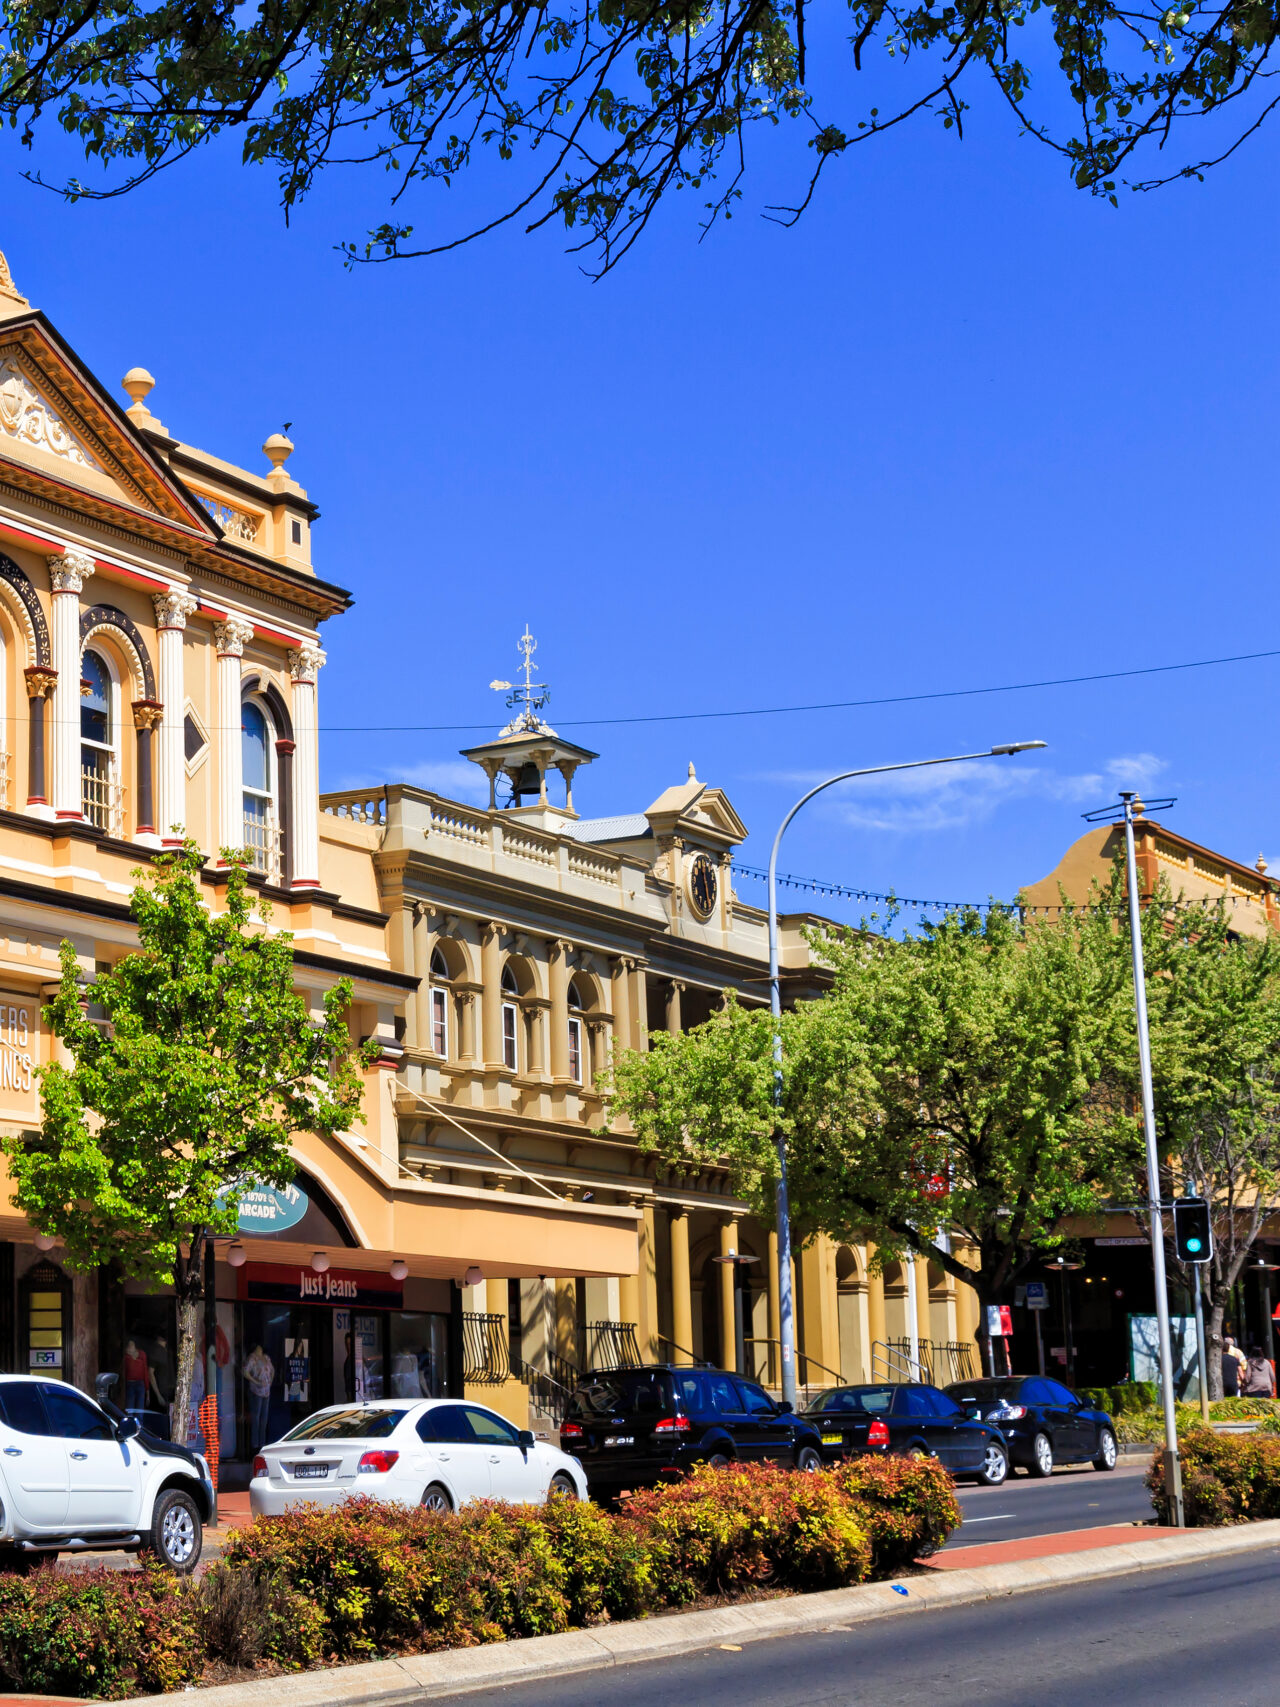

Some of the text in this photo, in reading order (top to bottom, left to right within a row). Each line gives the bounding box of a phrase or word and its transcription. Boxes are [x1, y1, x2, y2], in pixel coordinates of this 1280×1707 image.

[238, 1203, 276, 1219] ARCADE
[300, 1272, 358, 1299] Just Jeans
